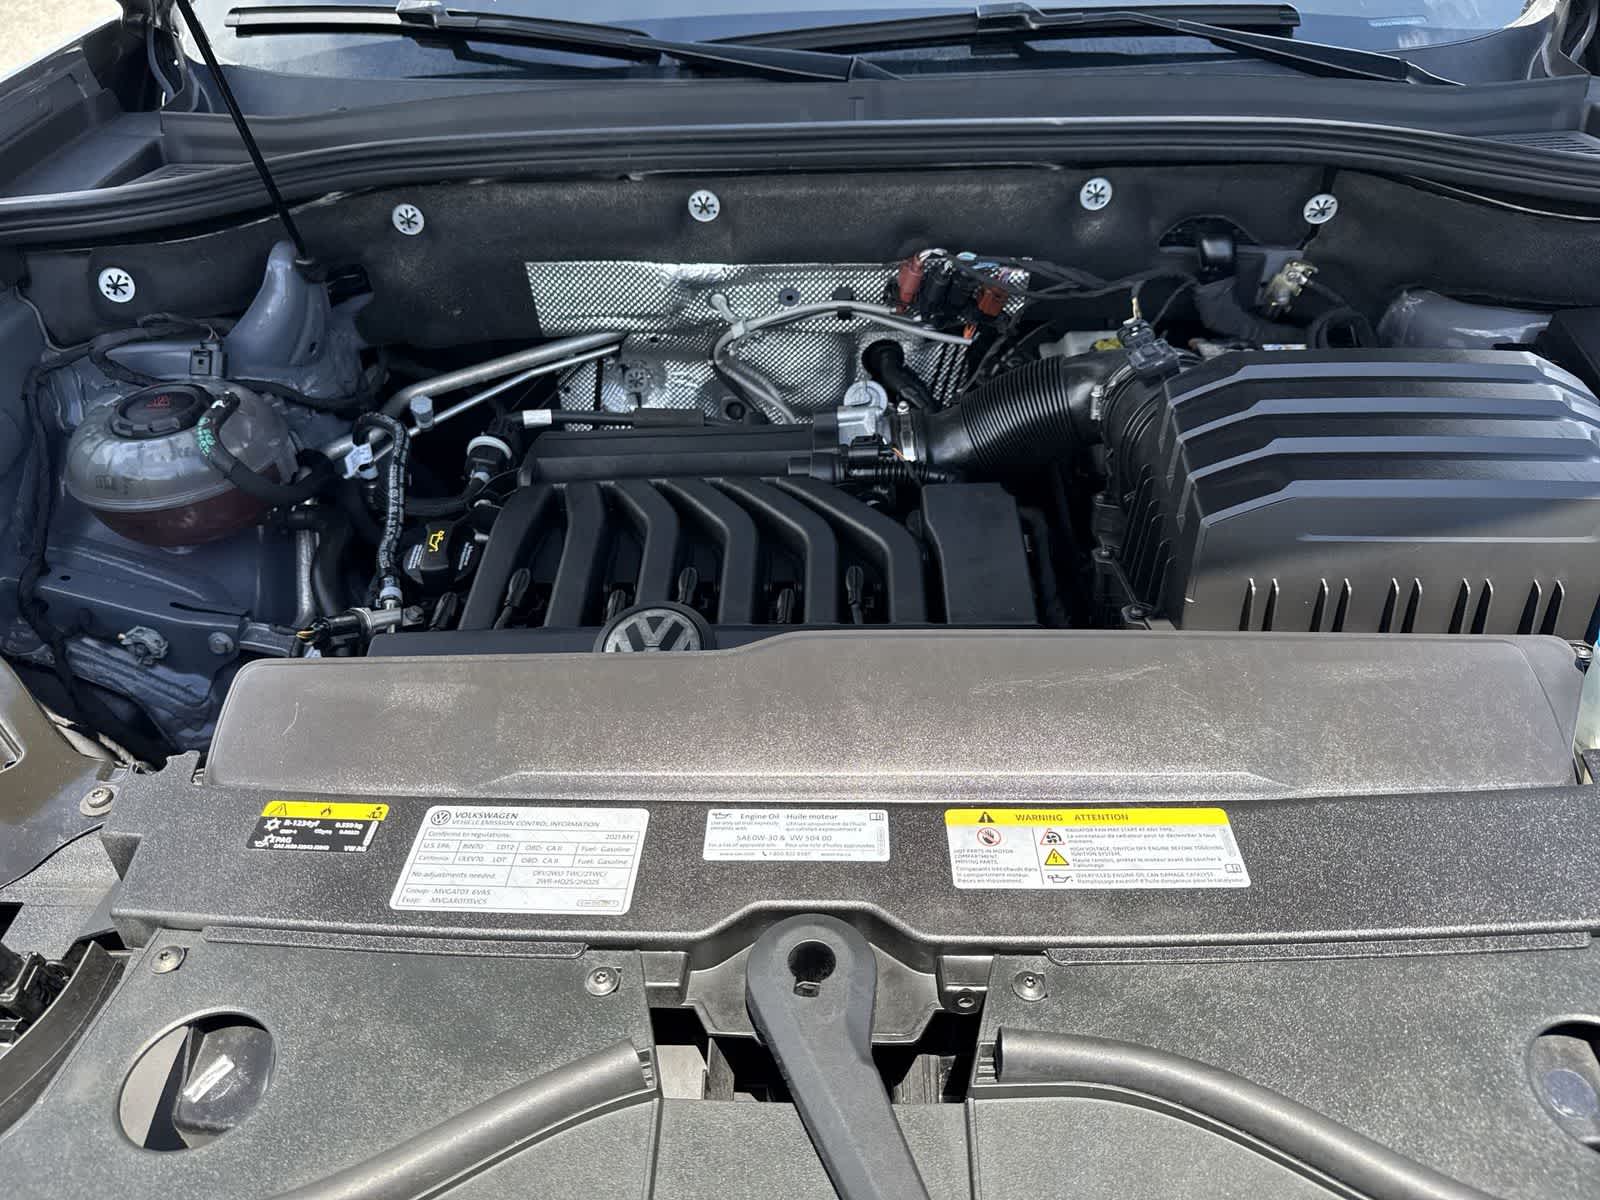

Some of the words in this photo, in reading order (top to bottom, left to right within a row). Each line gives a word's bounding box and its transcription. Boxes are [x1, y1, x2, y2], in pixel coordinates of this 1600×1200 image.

[740, 813, 767, 821] Engine
[283, 820, 320, 829] R-1234yf
[423, 871, 467, 879] adjustments
